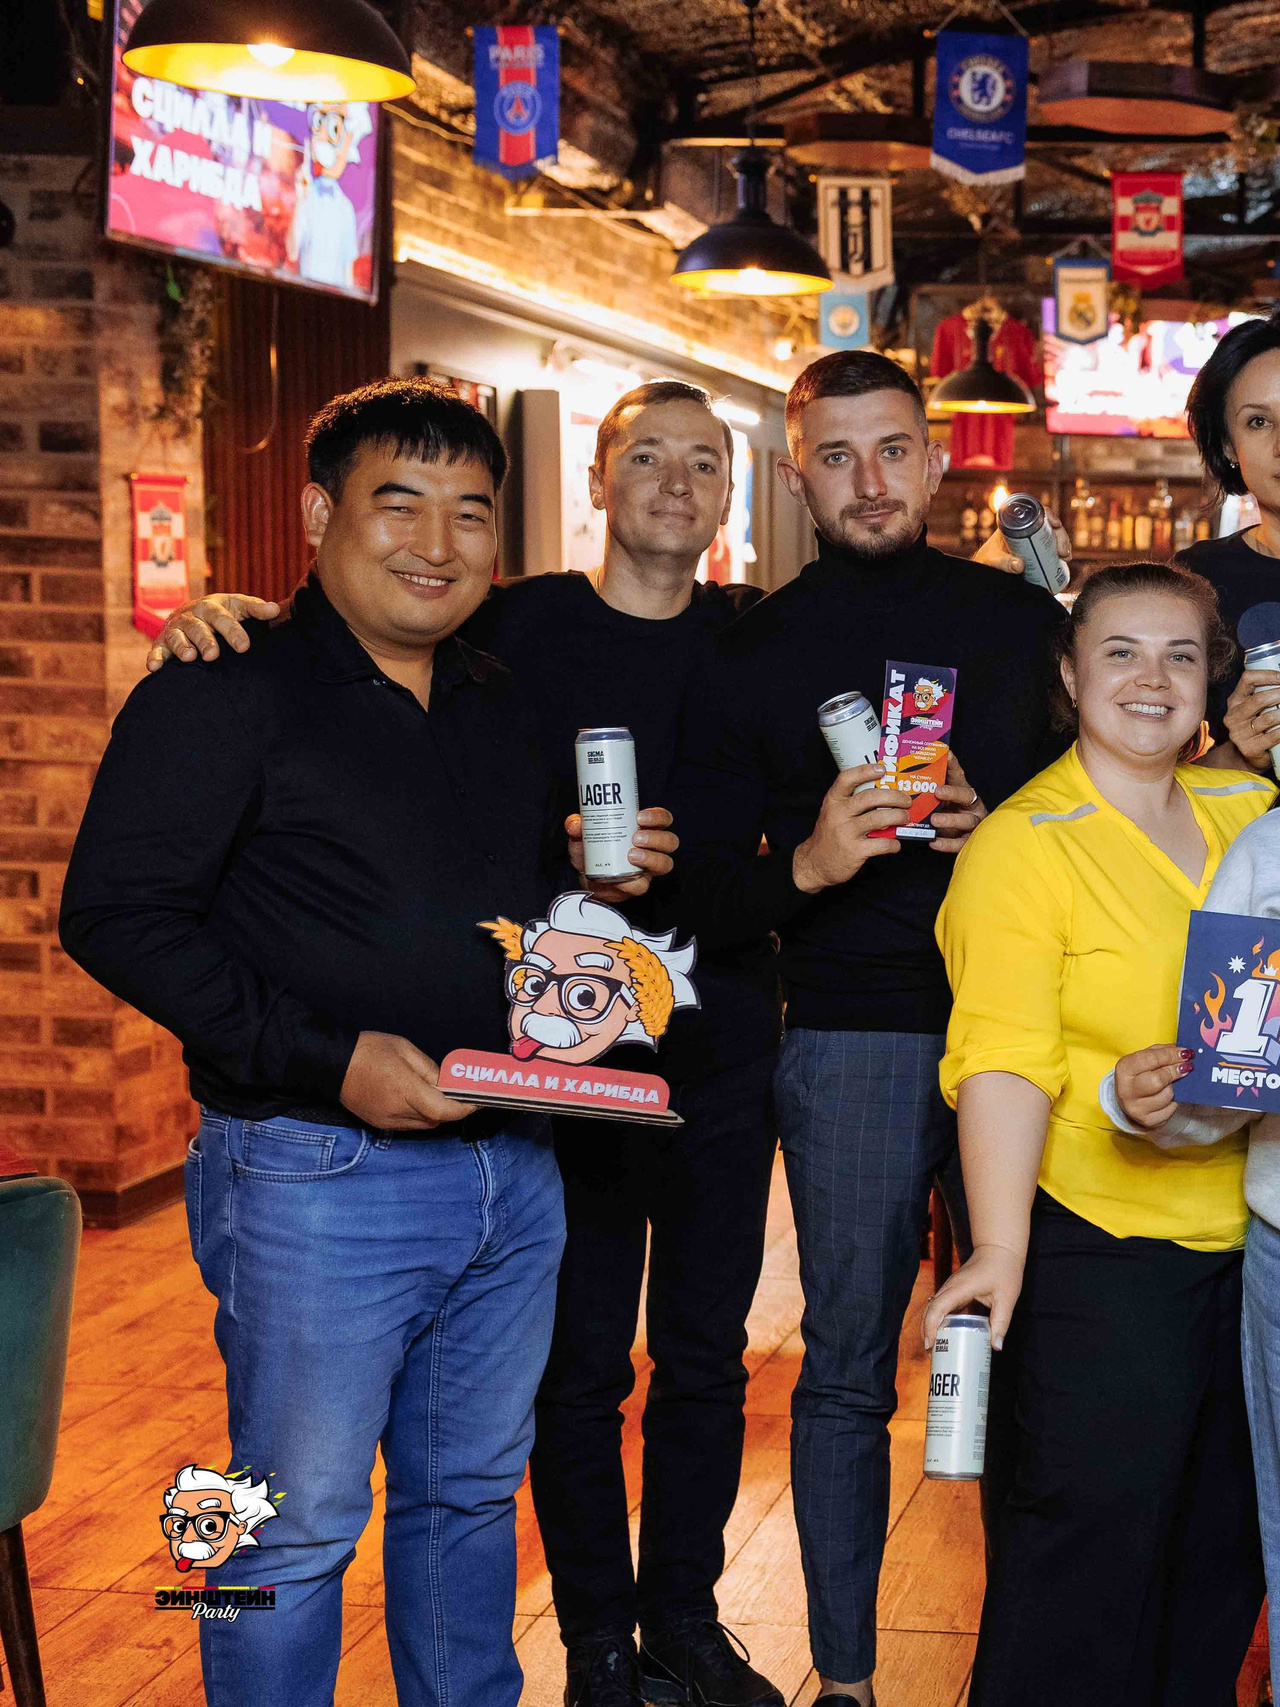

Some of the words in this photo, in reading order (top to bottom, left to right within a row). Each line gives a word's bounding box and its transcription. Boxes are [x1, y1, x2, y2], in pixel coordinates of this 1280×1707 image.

[880, 669, 906, 789] ТИФИКАТ
[580, 782, 623, 806] LAGER
[897, 780, 912, 792] 13
[1216, 977, 1277, 1058] 1
[450, 1062, 540, 1088] СЦИЛЛА
[544, 1075, 560, 1090] И
[563, 1078, 660, 1104] ХАРИБДА
[929, 1373, 960, 1397] AGER
